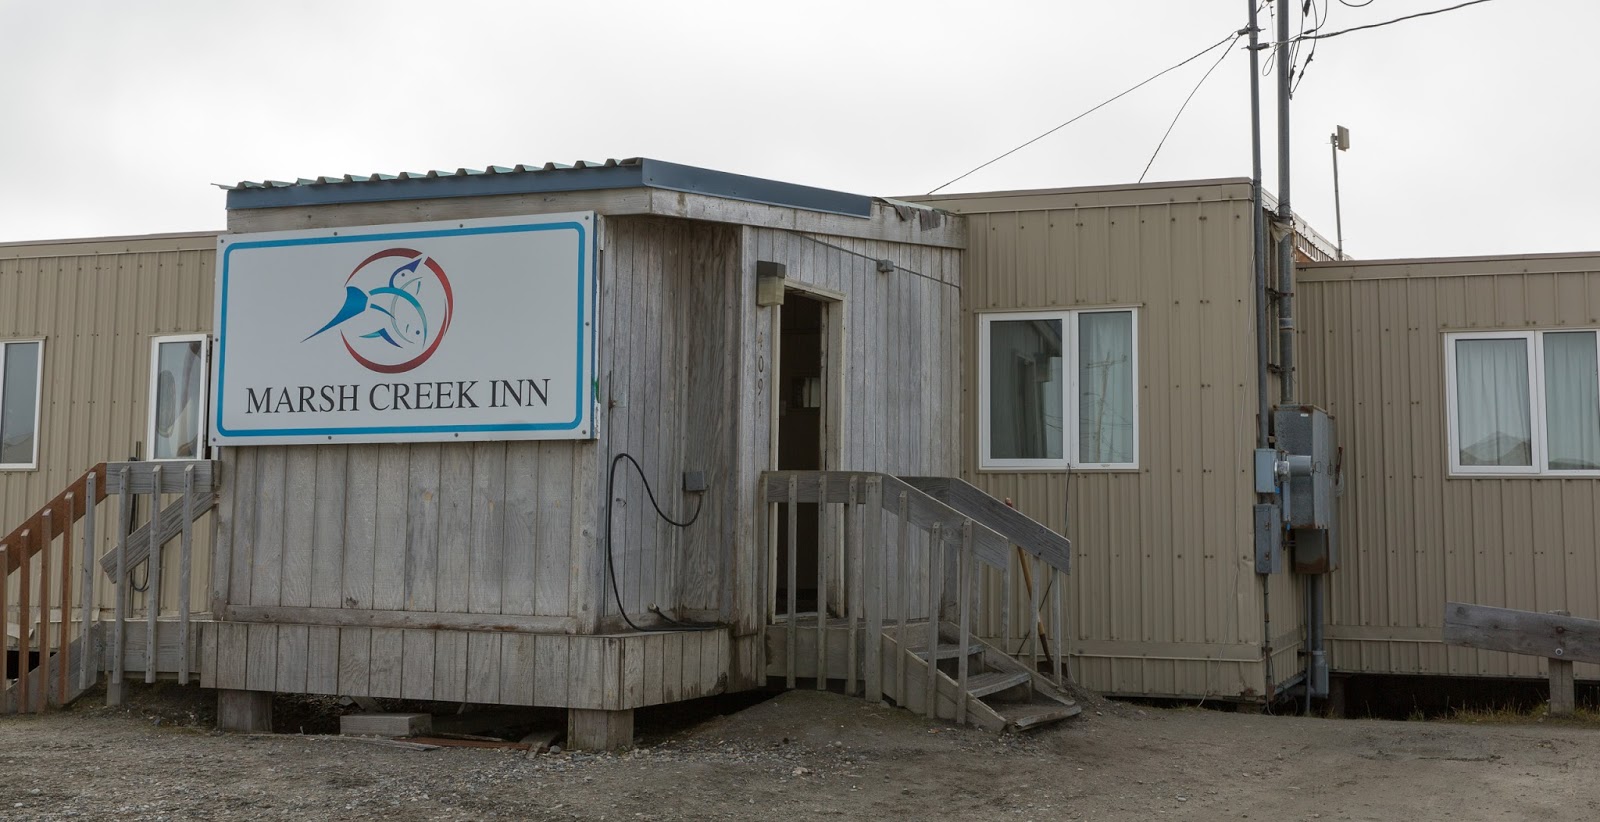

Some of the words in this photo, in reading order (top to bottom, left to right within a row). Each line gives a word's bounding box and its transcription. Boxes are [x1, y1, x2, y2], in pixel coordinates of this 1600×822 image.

[245, 384, 361, 414] MARSH
[369, 381, 479, 411] CREEK
[489, 378, 551, 408] INN
